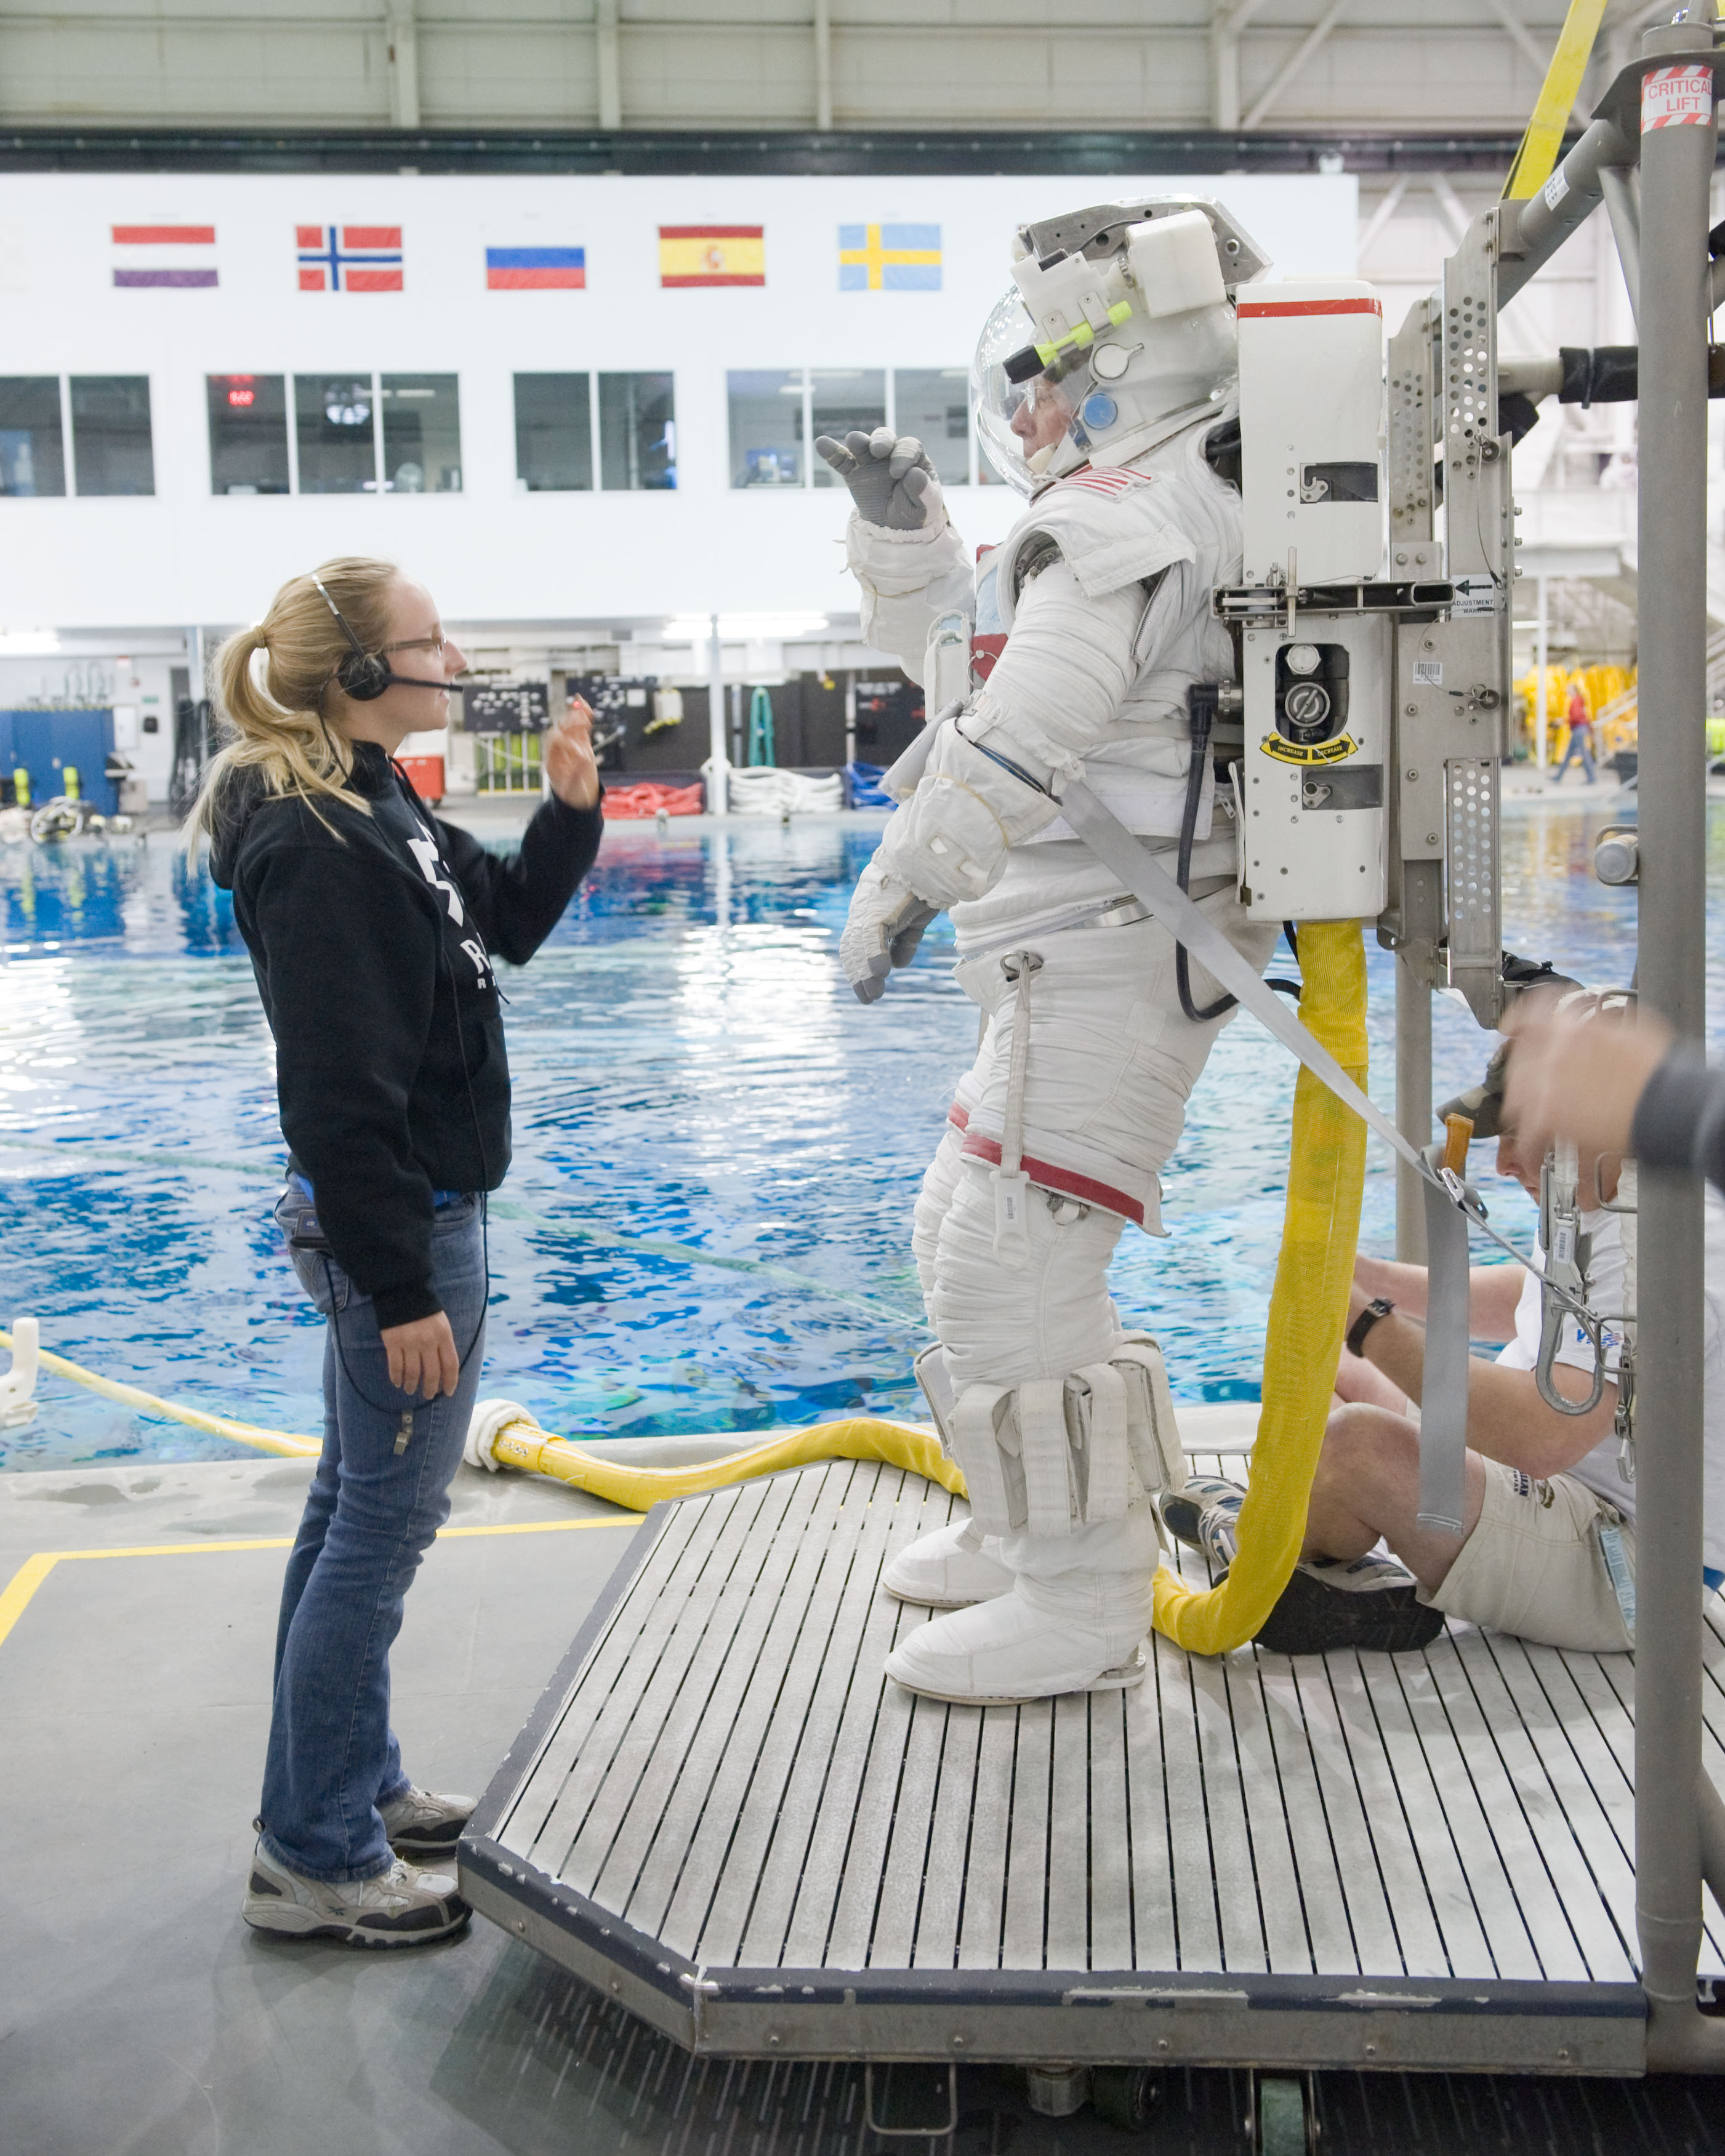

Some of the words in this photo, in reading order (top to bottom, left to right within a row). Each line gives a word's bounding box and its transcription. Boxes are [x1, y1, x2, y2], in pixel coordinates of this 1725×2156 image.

[1649, 79, 1711, 99] CRITICAL
[1667, 97, 1700, 112] LIFT
[1277, 745, 1303, 756] INCREASE
[1317, 745, 1343, 756] DECREASE
